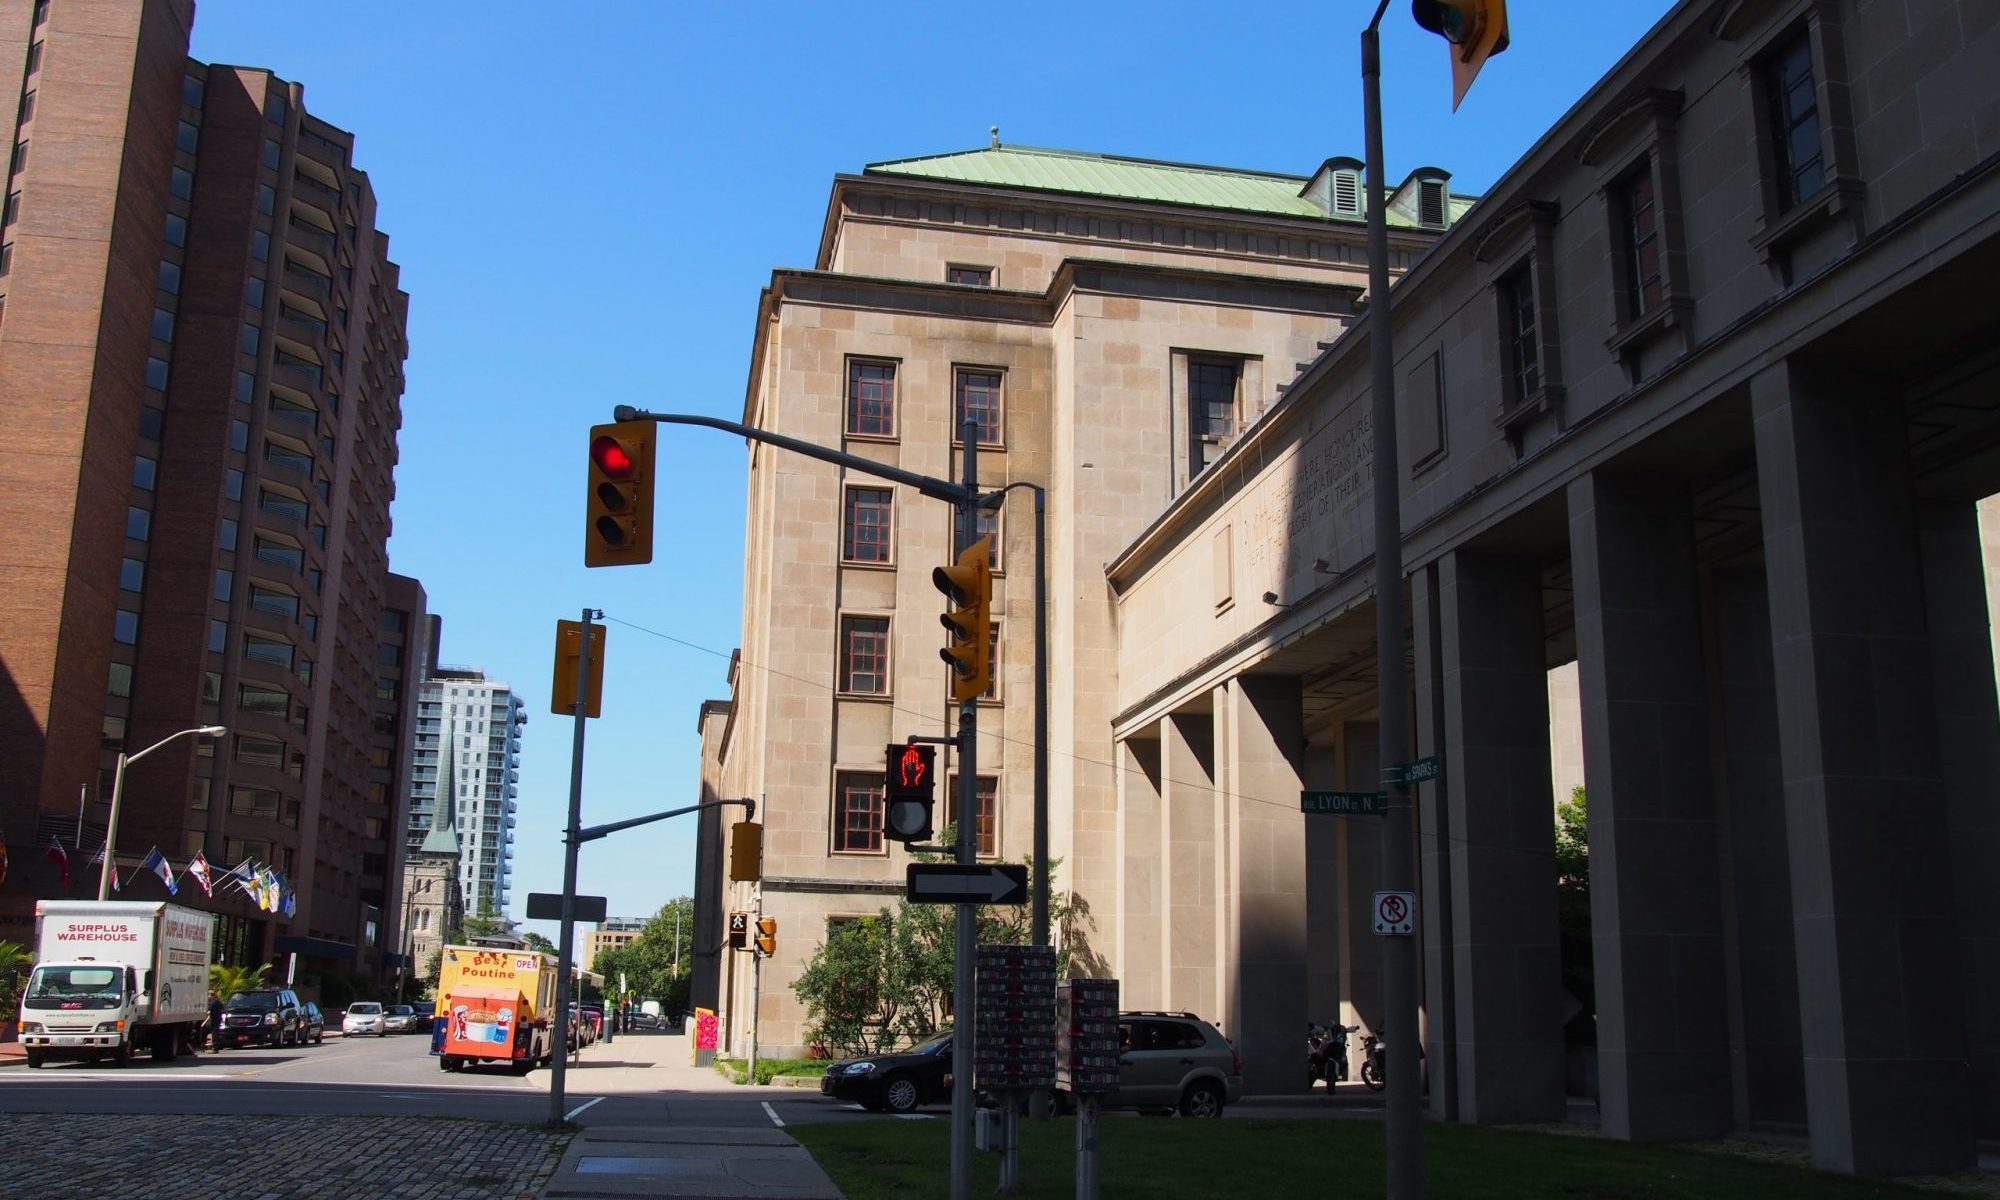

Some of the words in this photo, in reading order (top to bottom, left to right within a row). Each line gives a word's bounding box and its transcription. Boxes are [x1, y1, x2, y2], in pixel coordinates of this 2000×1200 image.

[1294, 452, 1352, 513] GENERATIONS
[1318, 495, 1329, 516] OF
[1335, 471, 1360, 503] THEIR
[1412, 761, 1432, 780] SPARKS
[1319, 795, 1350, 809] LYON
[1363, 796, 1371, 810] N
[68, 924, 128, 932] SURPLUS
[166, 919, 185, 939] SURPLUS
[57, 933, 138, 942] WAREHOUSE
[516, 960, 538, 969] OPEN
[462, 966, 515, 979] Poutine
